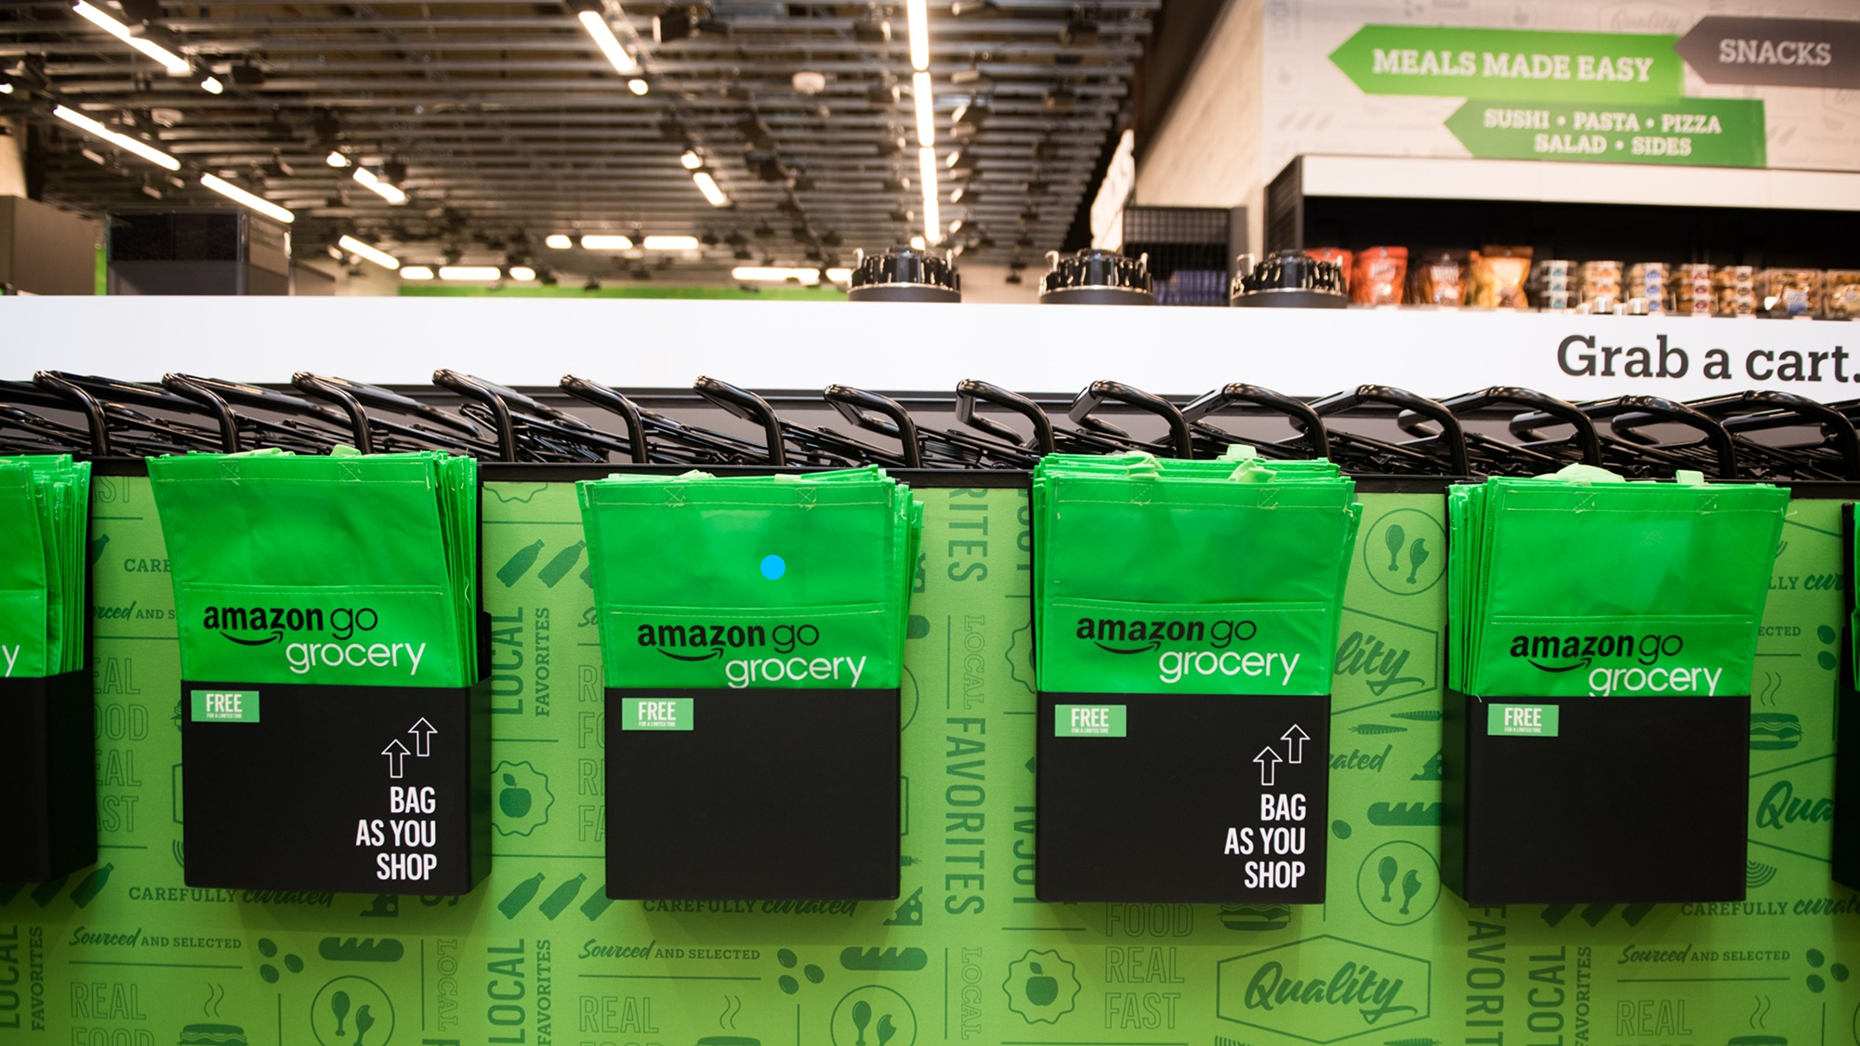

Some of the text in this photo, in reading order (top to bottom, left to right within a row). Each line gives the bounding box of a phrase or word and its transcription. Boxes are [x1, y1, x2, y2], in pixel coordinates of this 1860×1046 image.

[1372, 48, 1654, 82] MEALS MADE EASY
[1719, 38, 1832, 66] SNACKS
[1484, 108, 1722, 134] SUSHI PASTA PIZZA
[1534, 134, 1692, 156] SALAD SIDES
[1556, 334, 1860, 383] Grab a cart.
[135, 609, 164, 619] AND
[203, 606, 378, 641] amazon go
[637, 624, 819, 654] amazon go
[1076, 617, 1257, 649] amazon go
[285, 642, 426, 676] grocery
[535, 607, 550, 717] FAVORITES
[963, 614, 986, 711] LOCAL
[1509, 634, 1683, 666] amazon go
[725, 655, 867, 689] grocery
[1159, 651, 1301, 686] grocery
[1588, 667, 1723, 697] grocery
[206, 693, 243, 713] FREE
[638, 701, 677, 721] FREE
[1071, 708, 1110, 728] FREE
[1504, 707, 1542, 727] FREE
[389, 786, 437, 814] BAG
[944, 717, 986, 915] FAVORITES
[1260, 793, 1307, 822] BAG
[355, 819, 437, 848] AS YOU
[1224, 827, 1306, 855] AS YOU
[376, 852, 438, 881] SHOP
[1244, 861, 1306, 889] SHOP
[128, 886, 236, 904] CAREFULLY
[642, 900, 757, 914] CAREFULLY
[1681, 901, 1788, 917] CAREFULLY
[1105, 902, 1194, 938] FOOD
[69, 925, 242, 949] Sourced AND SELECTED
[578, 938, 761, 960] Sourced AND SELECTED
[1104, 946, 1186, 984] REAL
[1617, 944, 1790, 965] Sourced AND SELECTED
[29, 925, 46, 1032] FAVORITES
[437, 938, 459, 1032] LOCAL
[487, 938, 526, 1044] LOCAL
[536, 939, 552, 1046] FAVORITES
[961, 947, 983, 1040] LOCAL
[1244, 961, 1418, 1025] Quality
[70, 981, 147, 1021] REAL
[1104, 992, 1181, 1030] FAST
[1526, 946, 1566, 1046] LOCAL
[578, 996, 660, 1034] REAL
[1616, 1000, 1693, 1037] REAL
